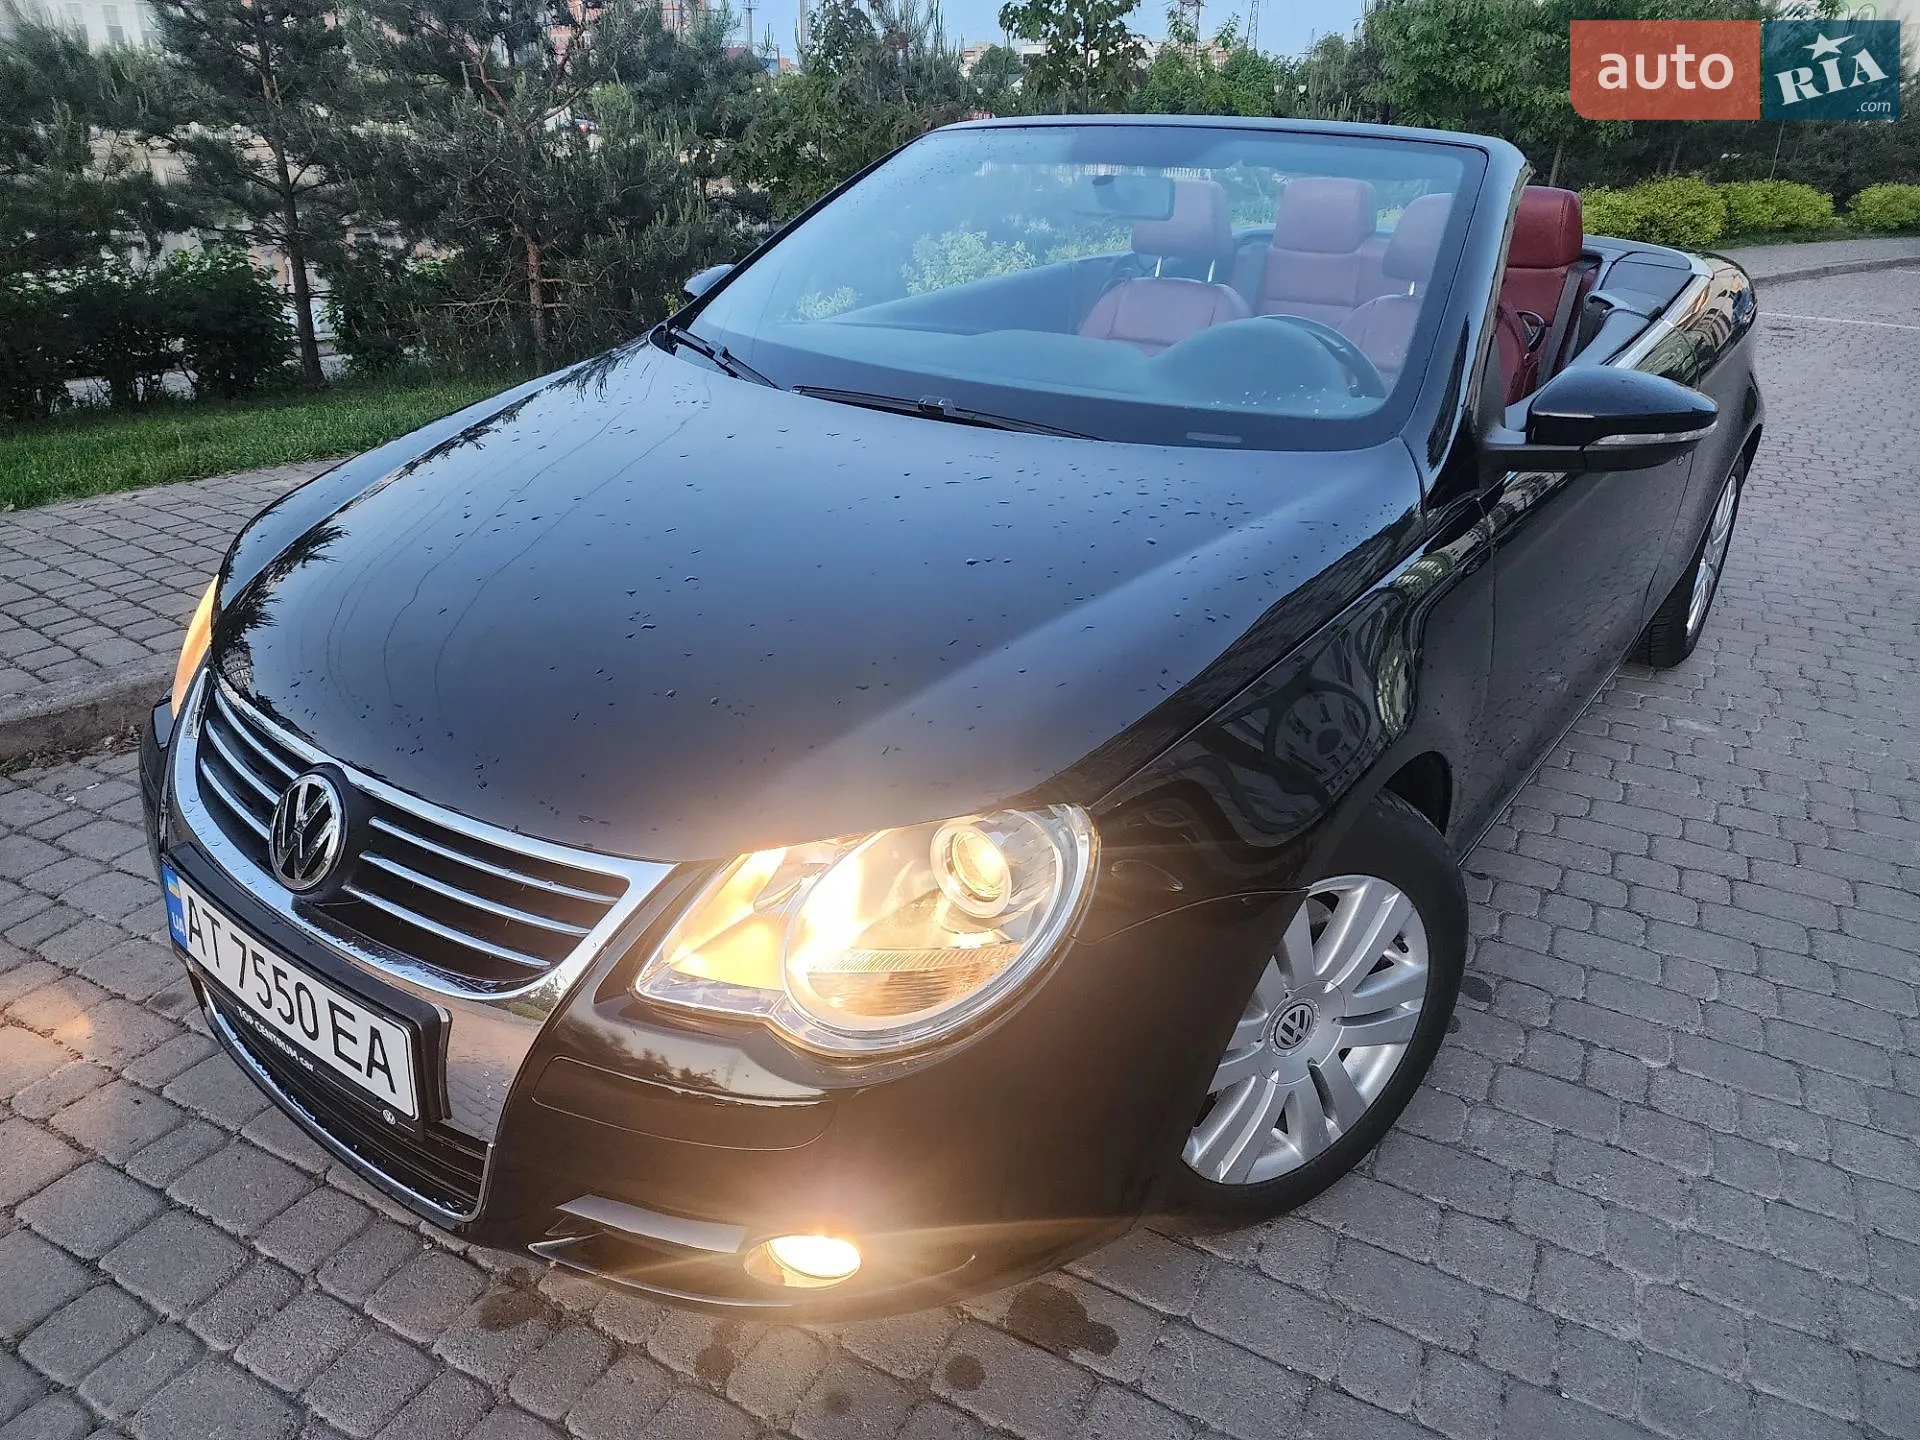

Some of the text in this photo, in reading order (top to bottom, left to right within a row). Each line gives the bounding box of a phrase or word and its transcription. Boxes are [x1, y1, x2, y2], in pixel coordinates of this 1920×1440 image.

[171, 911, 186, 937] UA
[187, 895, 397, 1095] AT 7550 EA
